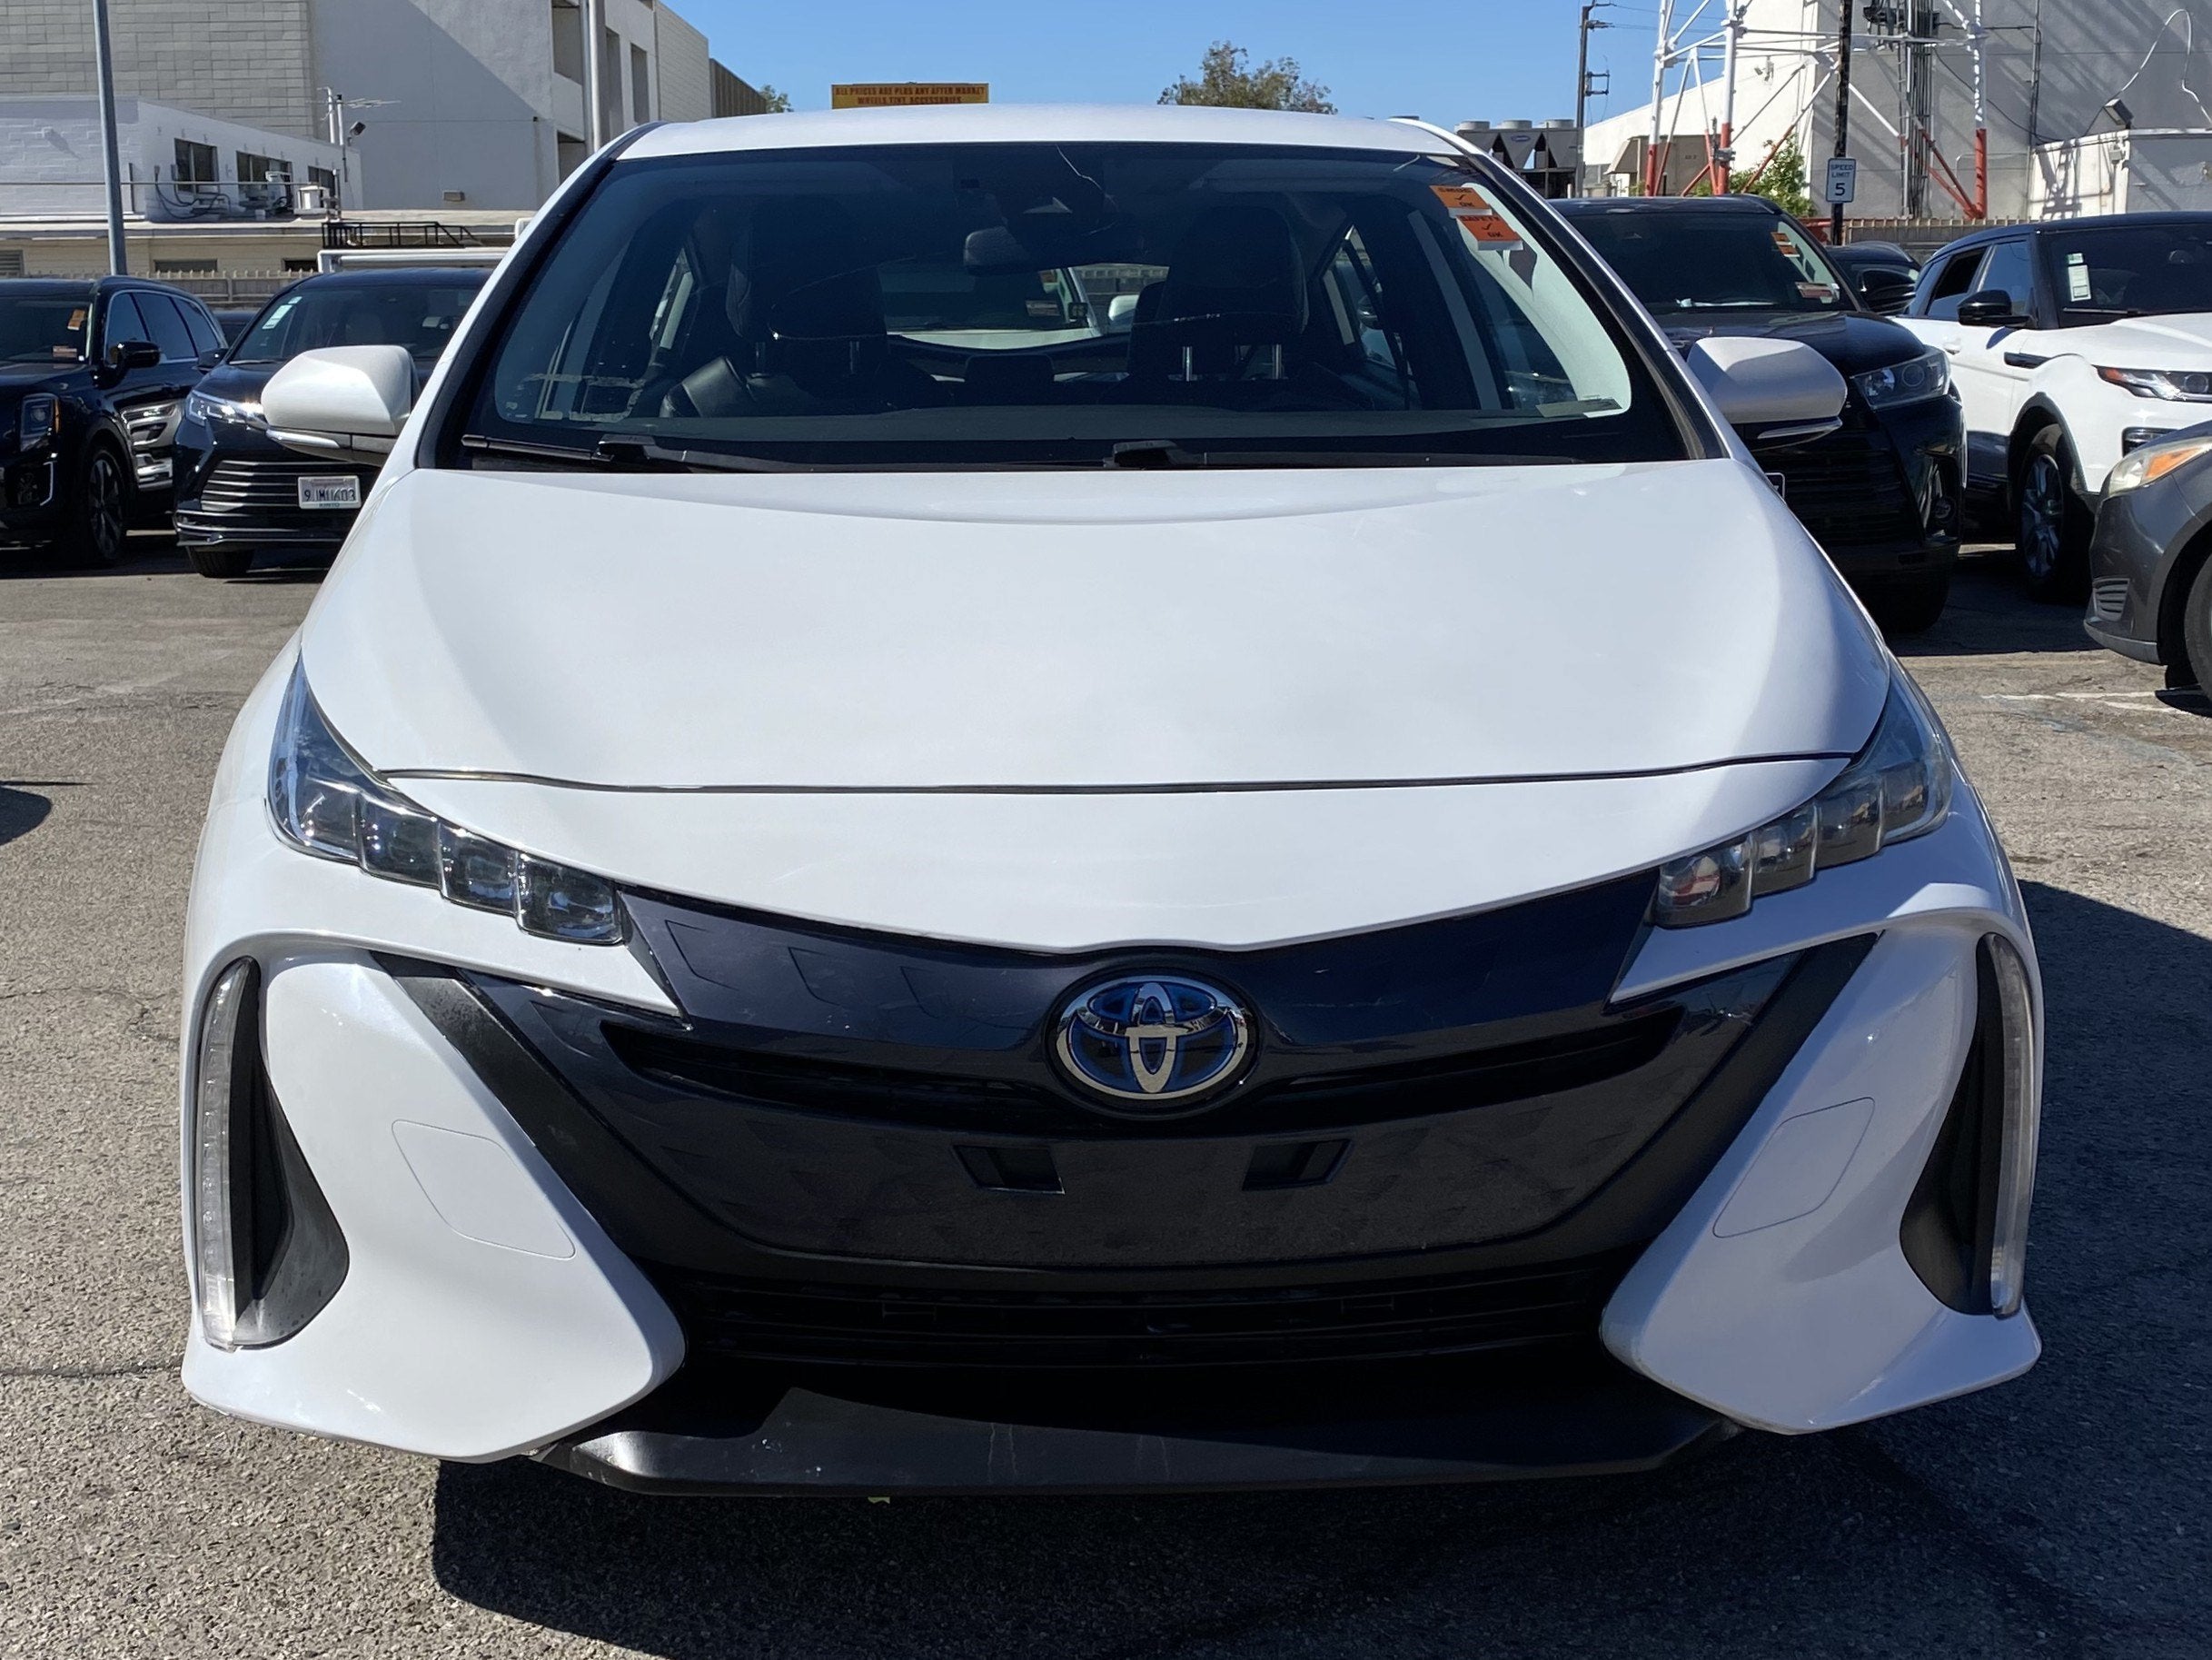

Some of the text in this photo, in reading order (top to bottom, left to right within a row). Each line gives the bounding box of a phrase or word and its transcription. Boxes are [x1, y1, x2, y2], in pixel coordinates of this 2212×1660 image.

[850, 87, 877, 95] PRICES
[931, 86, 953, 94] AFTER
[955, 86, 985, 94] MARKET
[1835, 183, 1845, 196] 5
